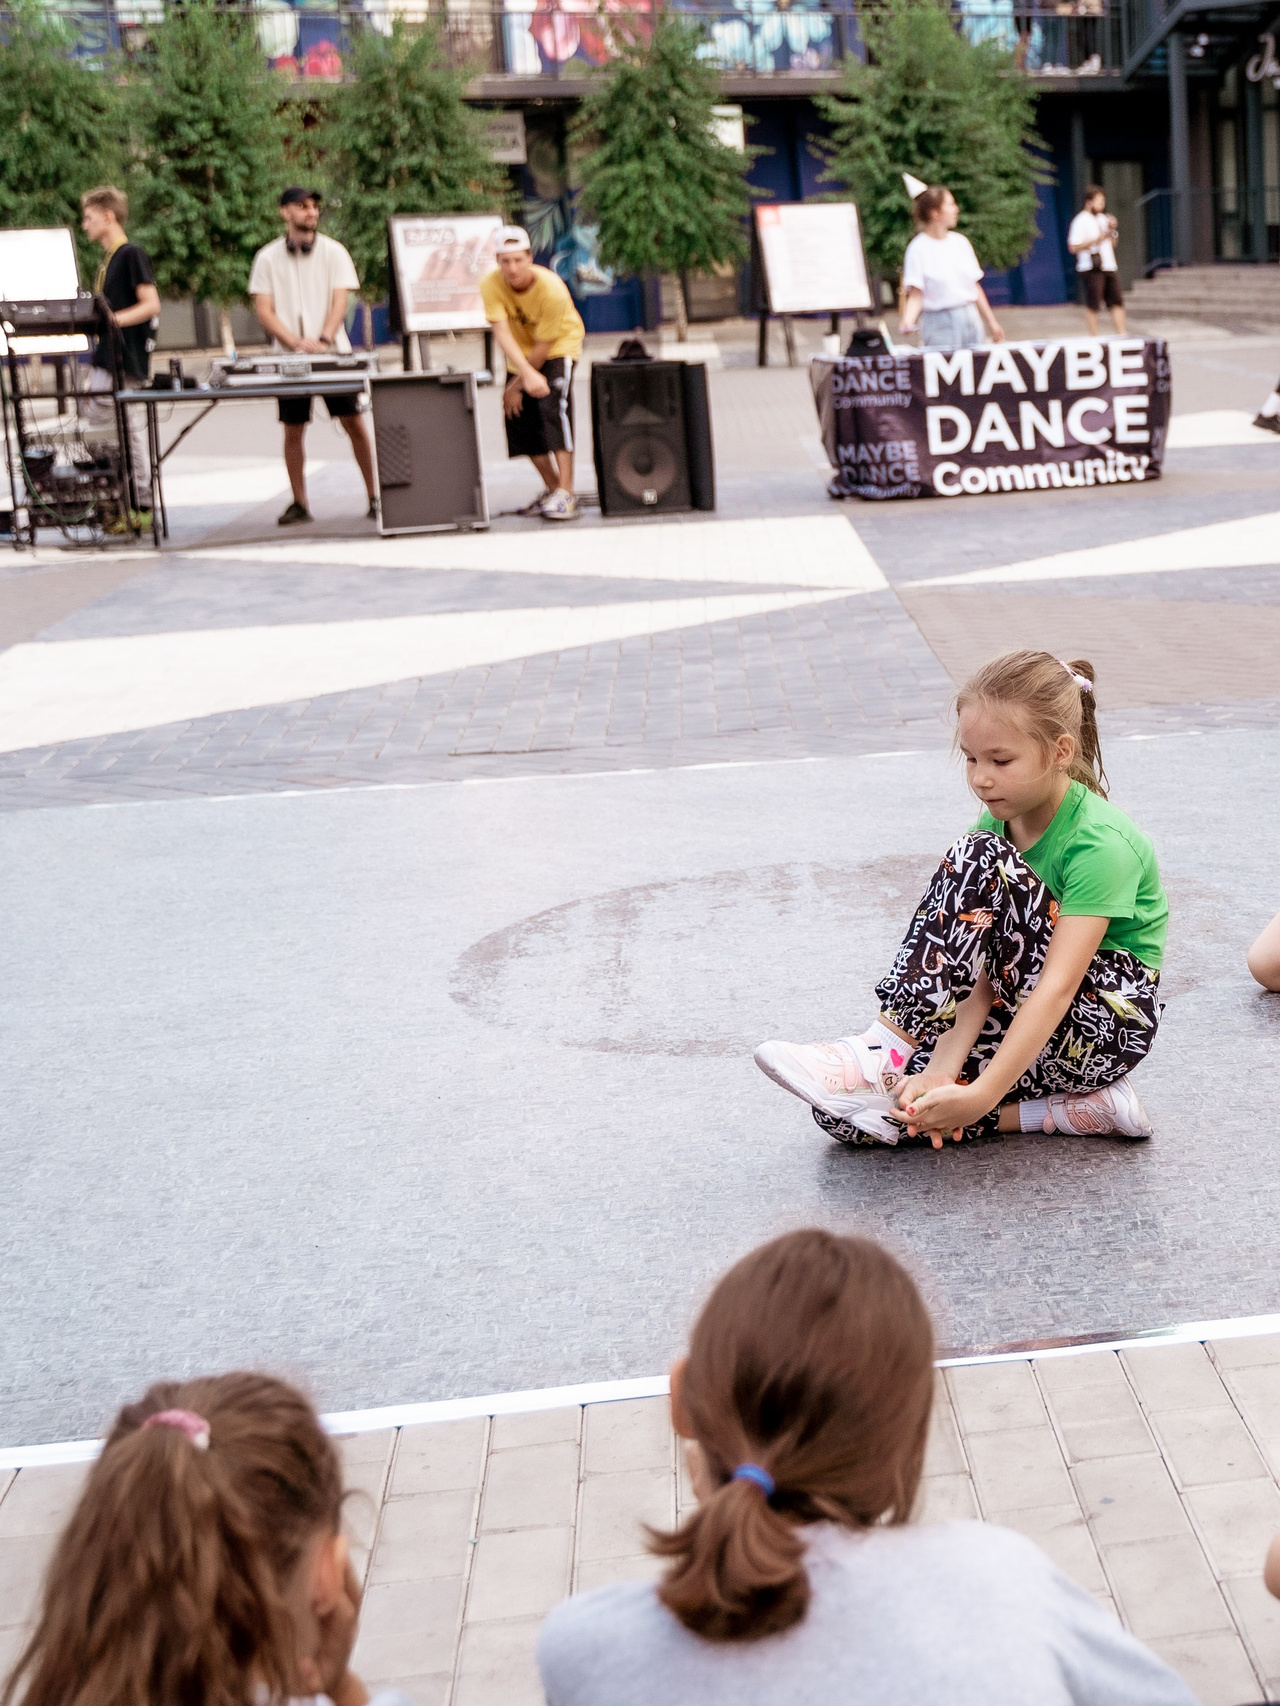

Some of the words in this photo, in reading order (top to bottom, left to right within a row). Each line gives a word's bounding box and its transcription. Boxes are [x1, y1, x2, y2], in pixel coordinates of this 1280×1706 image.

[832, 370, 911, 394] DANCE
[923, 339, 1149, 398] MAYBE
[926, 395, 1150, 455] DANCE
[837, 440, 918, 464] MAYBE
[840, 461, 921, 486] DANCE
[933, 450, 1150, 496] Community
